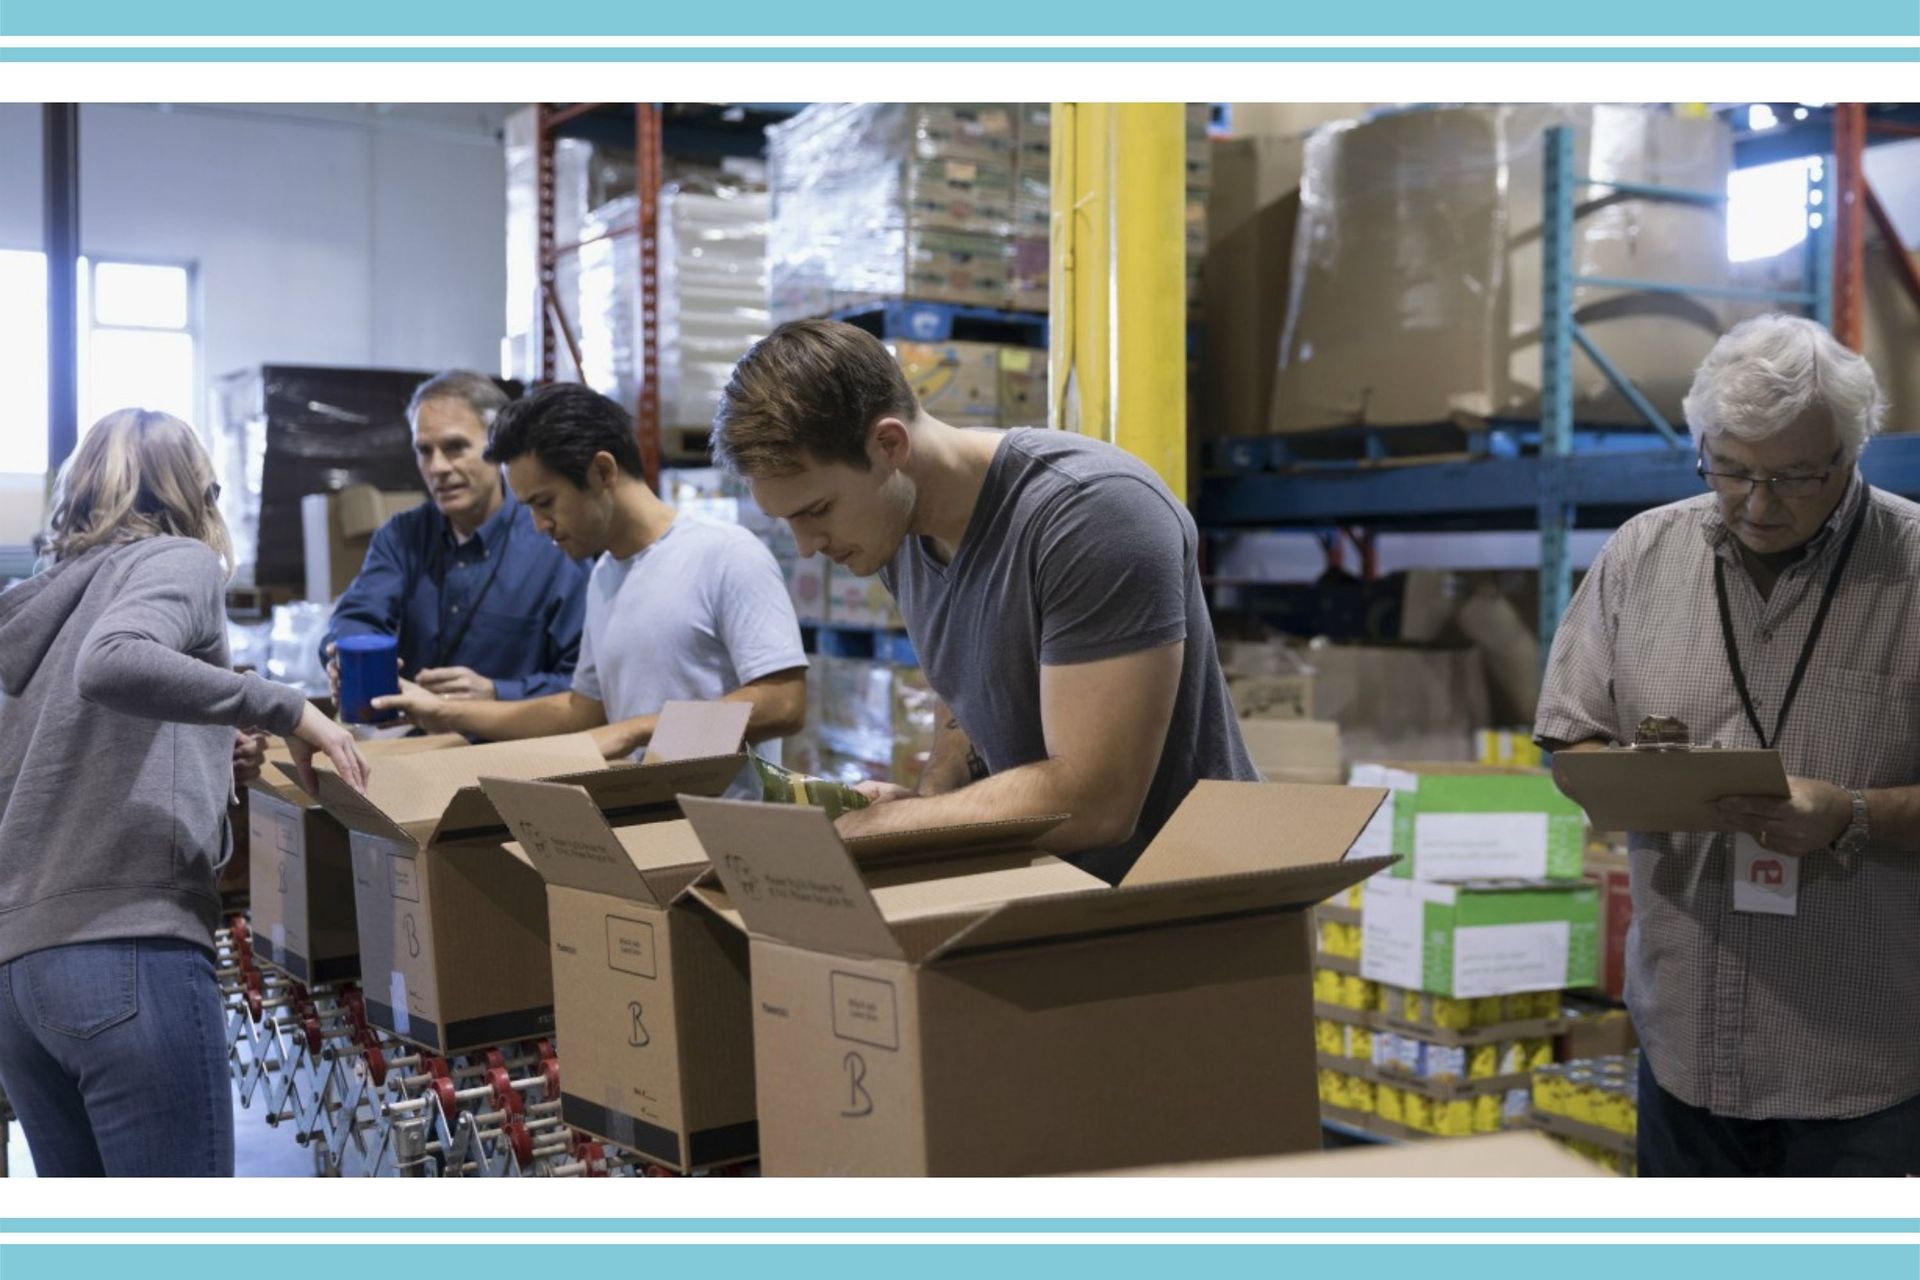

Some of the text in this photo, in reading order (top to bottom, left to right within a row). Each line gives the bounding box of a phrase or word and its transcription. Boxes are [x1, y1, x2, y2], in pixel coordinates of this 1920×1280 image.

[403, 912, 420, 959] B
[627, 1000, 650, 1048] B
[840, 1051, 874, 1118] B
